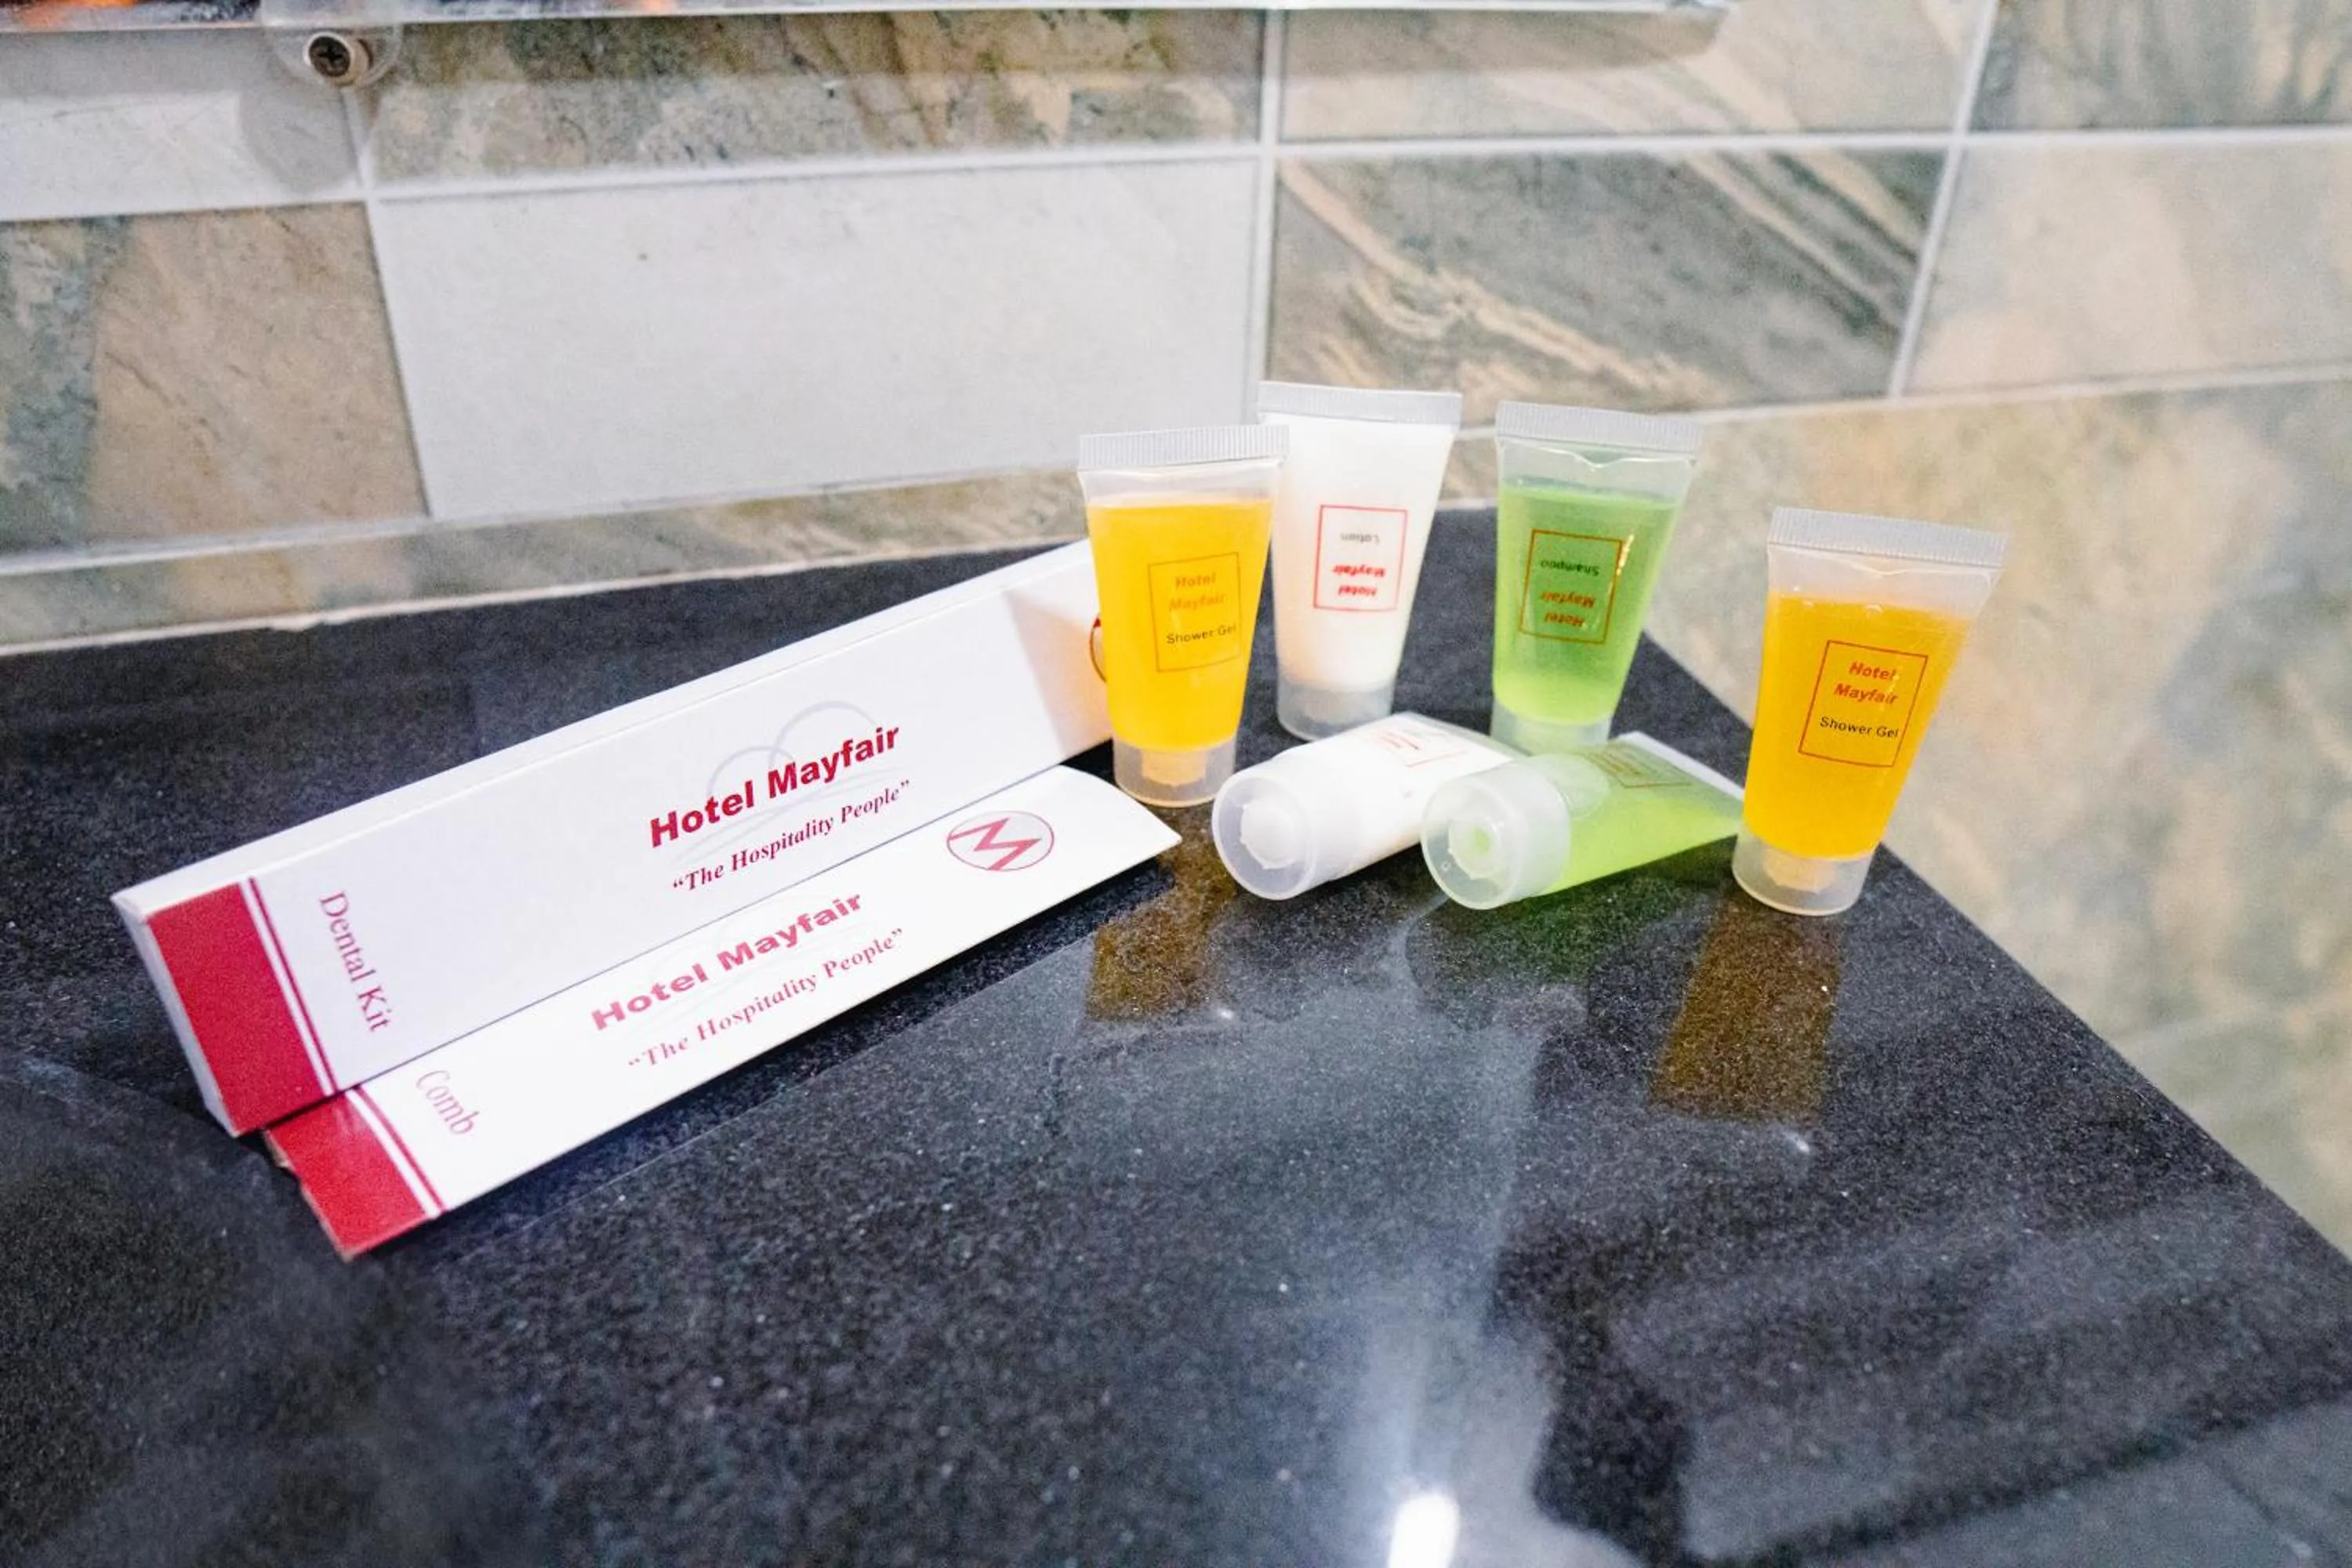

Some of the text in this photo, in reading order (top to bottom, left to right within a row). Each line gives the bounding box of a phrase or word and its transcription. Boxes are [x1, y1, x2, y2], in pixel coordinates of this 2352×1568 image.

[1339, 532, 1381, 545] Lotion
[1332, 563, 1385, 578] Mayfair
[1540, 559, 1600, 577] Shampoo
[1175, 572, 1216, 589] Hotel
[1338, 586, 1377, 597] Hotel
[1541, 590, 1596, 608] Mayfair
[1169, 593, 1227, 612] Mayfair
[1544, 612, 1586, 628] Hotel
[1166, 622, 1237, 644] Shower Gel
[1849, 661, 1897, 681] Hotel
[1834, 683, 1899, 705] Mayfair
[1819, 716, 1900, 739] Shower Gel
[649, 727, 899, 848] Hotel Mayfair
[731, 816, 834, 872] Hospitality
[318, 891, 393, 1033] Dental Kit
[590, 894, 862, 1031] Hotel Mayfair
[696, 973, 818, 1041] Hospitality
[416, 1069, 481, 1135] Comb
